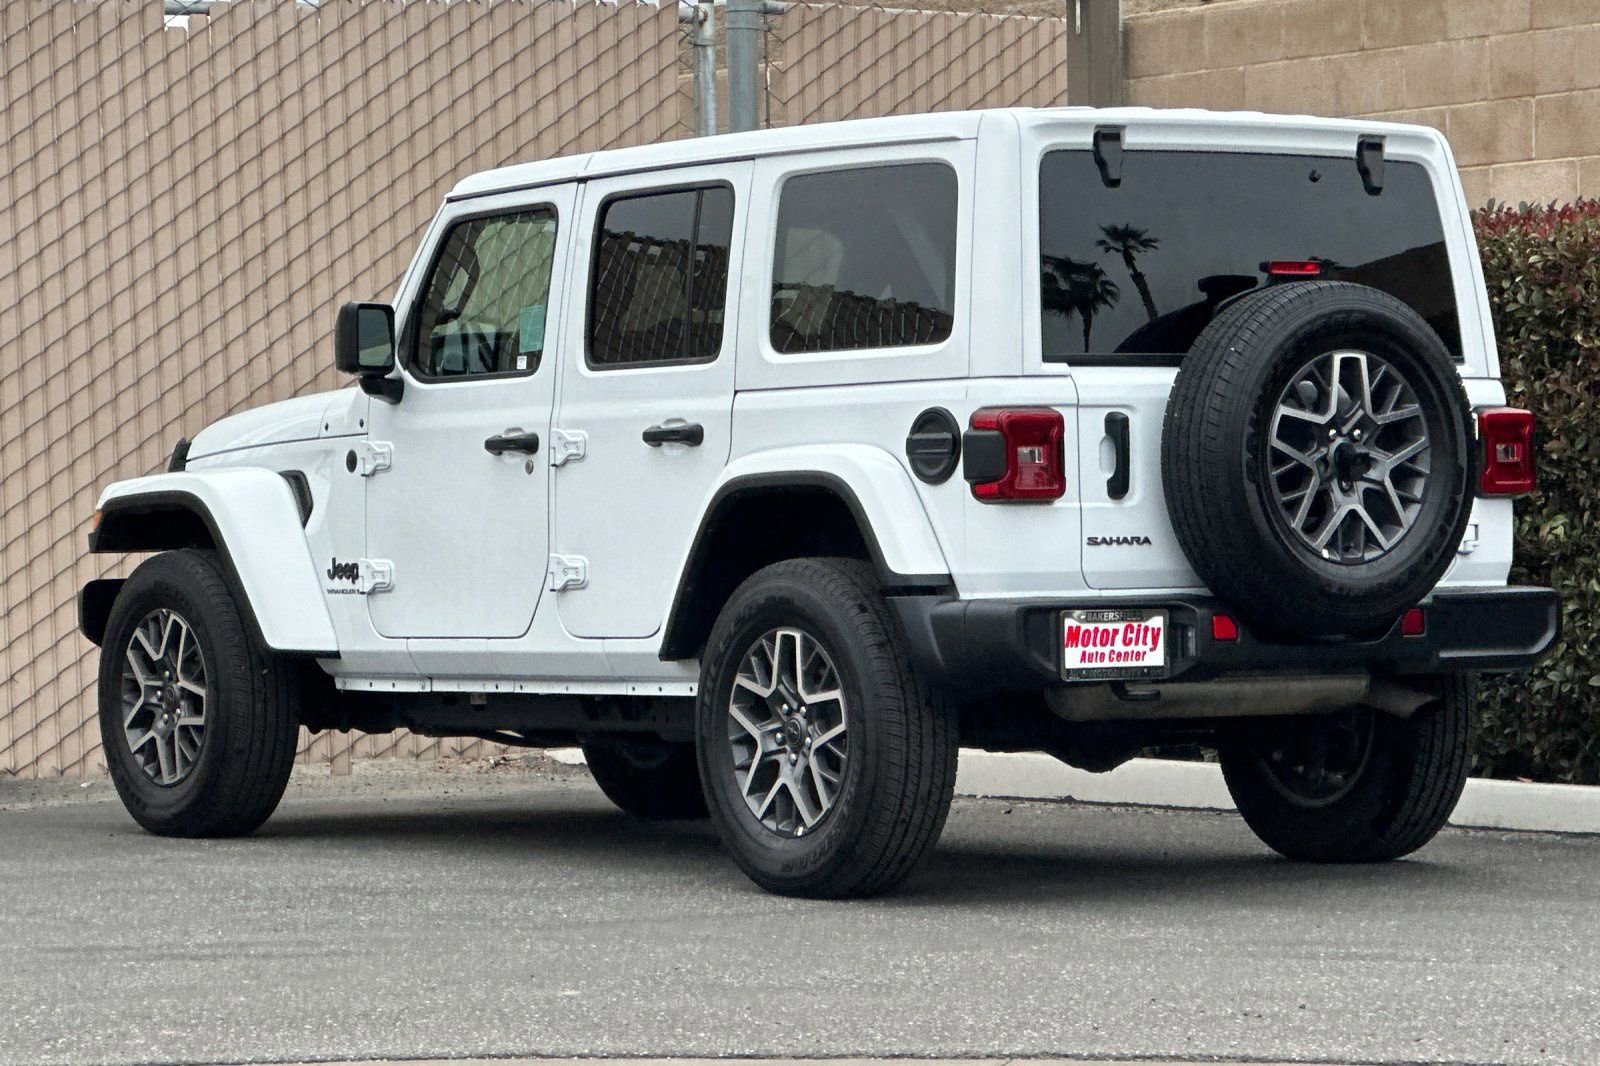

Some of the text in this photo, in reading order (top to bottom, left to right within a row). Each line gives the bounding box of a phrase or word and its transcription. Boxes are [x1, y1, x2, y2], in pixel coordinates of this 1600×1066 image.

[1086, 536, 1152, 546] SAHARA
[327, 557, 359, 584] Jeep
[1064, 623, 1161, 652] Motor City
[1080, 649, 1147, 663] Auto Center
